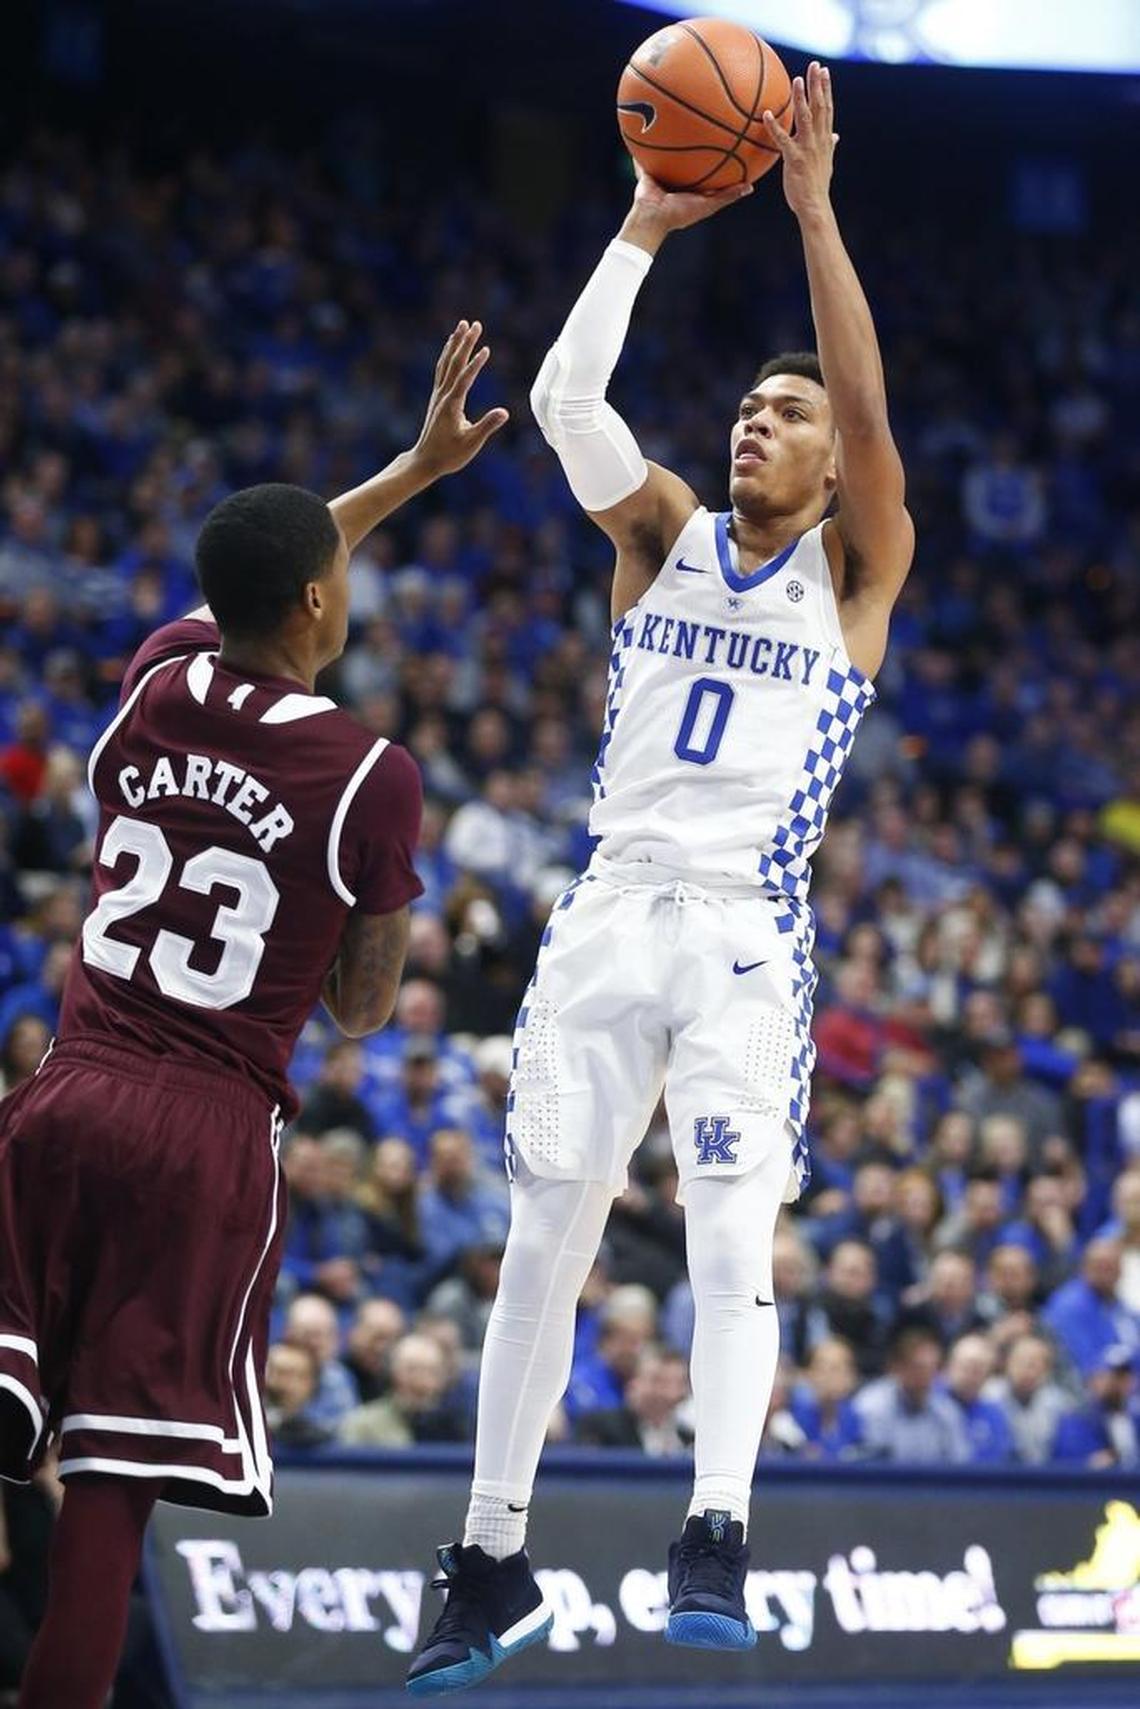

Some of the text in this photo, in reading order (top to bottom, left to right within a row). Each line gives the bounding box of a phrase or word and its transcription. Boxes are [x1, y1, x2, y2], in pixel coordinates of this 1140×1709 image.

[638, 613, 820, 686] KENTUCKY
[673, 677, 735, 766] 0
[118, 754, 295, 854] CARTER
[82, 814, 281, 1011] 23
[175, 1539, 424, 1652] Every
[619, 1567, 817, 1651] ery
